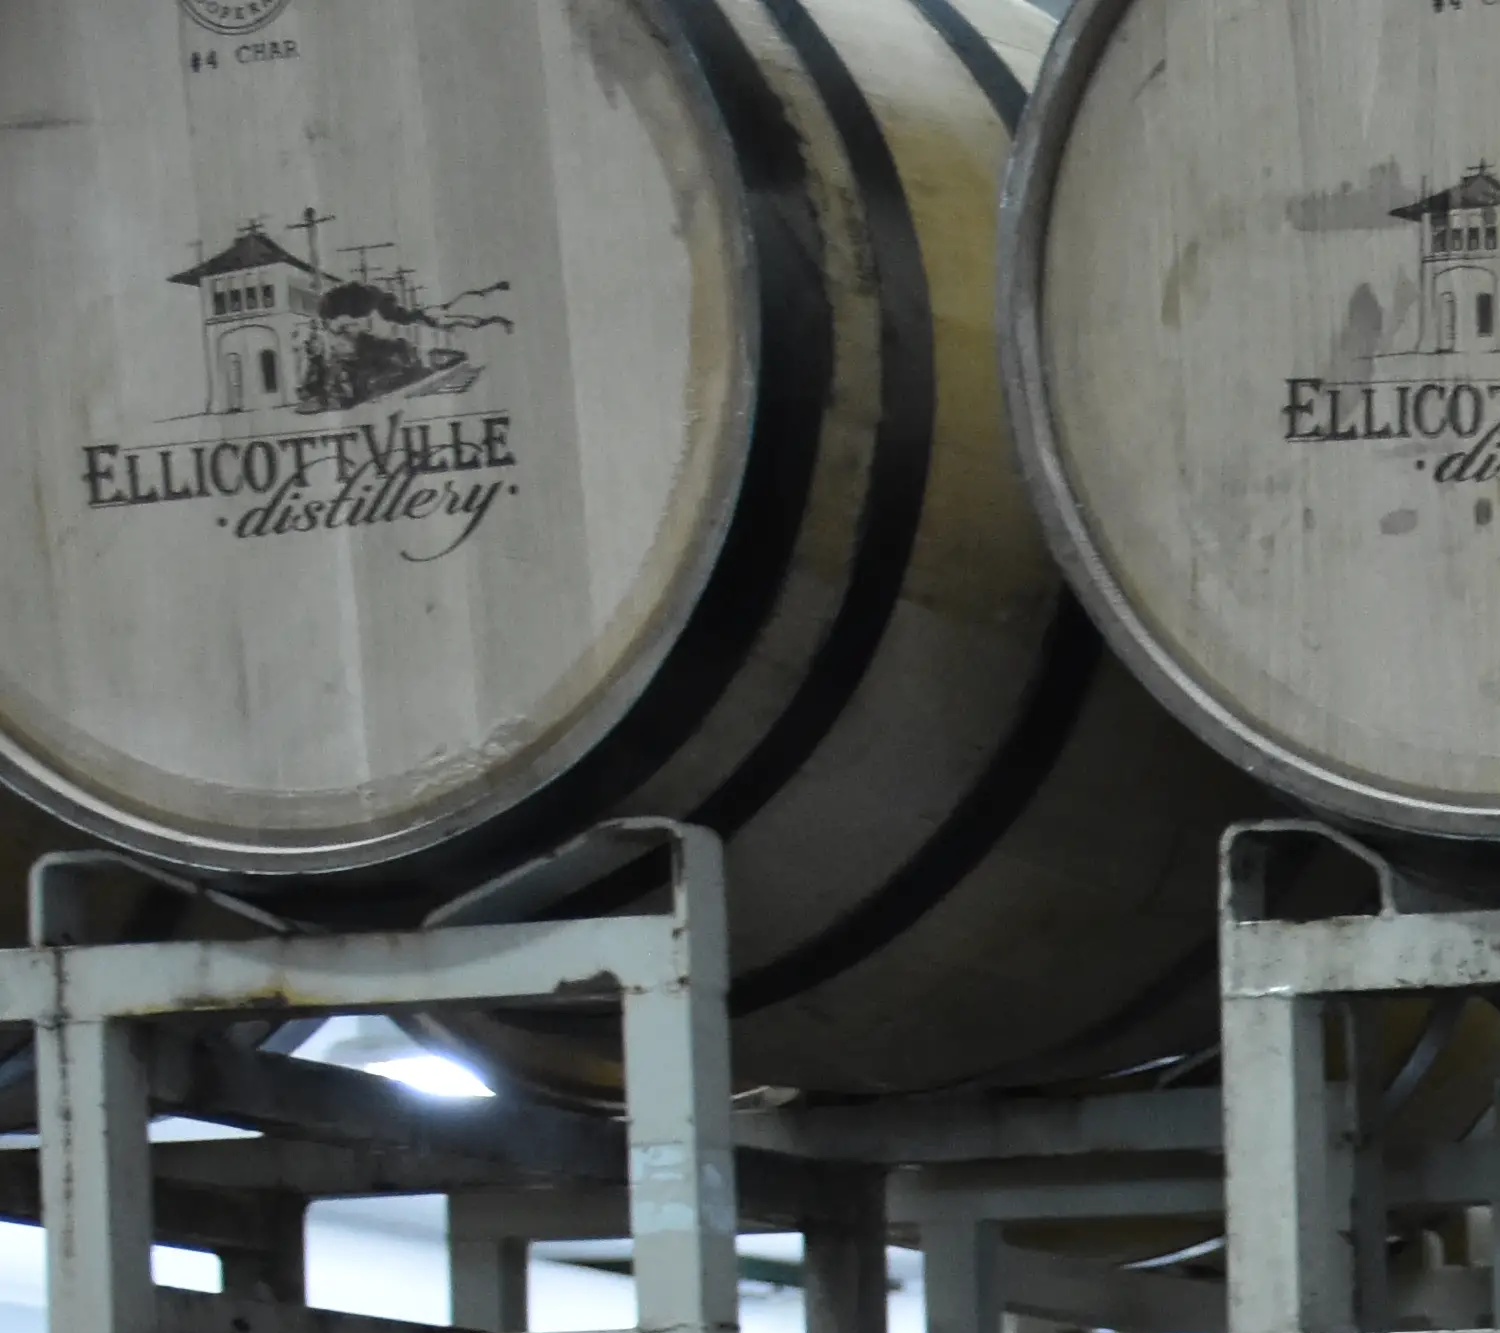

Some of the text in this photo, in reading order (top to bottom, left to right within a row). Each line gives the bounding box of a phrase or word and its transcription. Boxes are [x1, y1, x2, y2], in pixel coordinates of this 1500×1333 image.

[234, 40, 300, 66] CHAR
[82, 411, 516, 508] ELLICOTTVILLE
[232, 442, 507, 562] distillery
